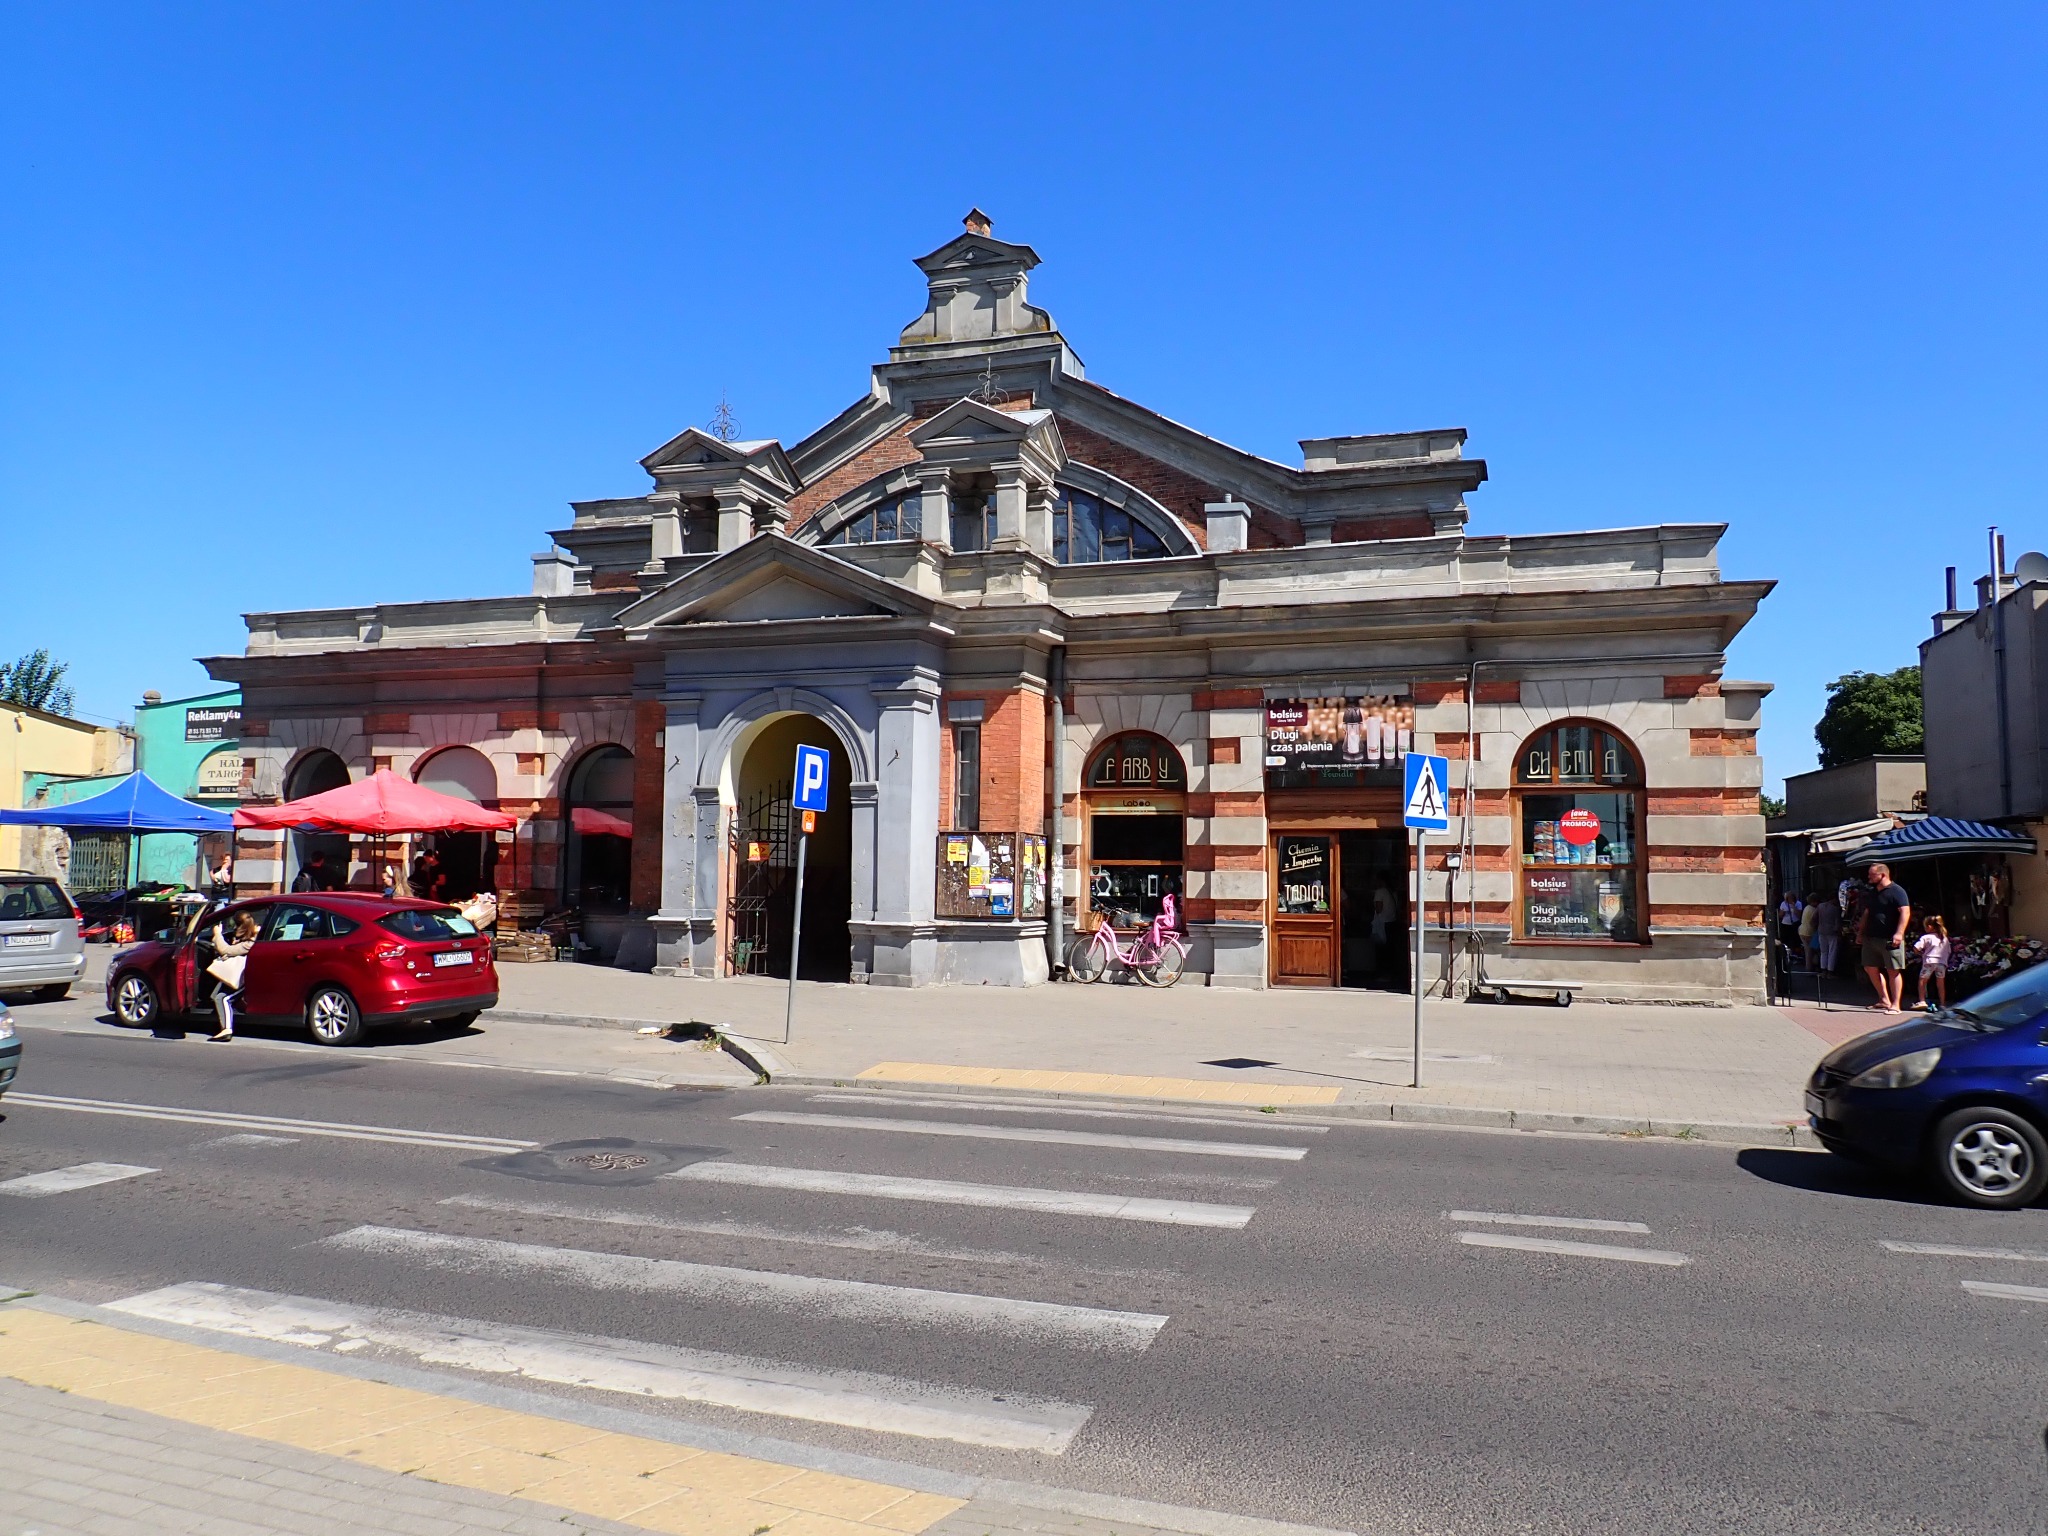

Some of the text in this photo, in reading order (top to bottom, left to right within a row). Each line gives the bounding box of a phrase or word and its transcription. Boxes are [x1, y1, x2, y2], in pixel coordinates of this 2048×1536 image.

[188, 710, 241, 722] Reklamy4u
[1270, 708, 1303, 719] bolsius
[1271, 730, 1299, 741] Długi
[1295, 741, 1333, 753] palenia
[1106, 757, 1168, 779] FARBY
[1530, 750, 1617, 774] CHEMIA
[802, 754, 823, 801] P
[1288, 844, 1319, 855] Chemia
[1292, 855, 1323, 868] Importu
[1531, 877, 1567, 888] bolsius
[1284, 885, 1324, 902] TANIO!
[1531, 906, 1557, 916] Długi
[1553, 914, 1589, 925] palenia
